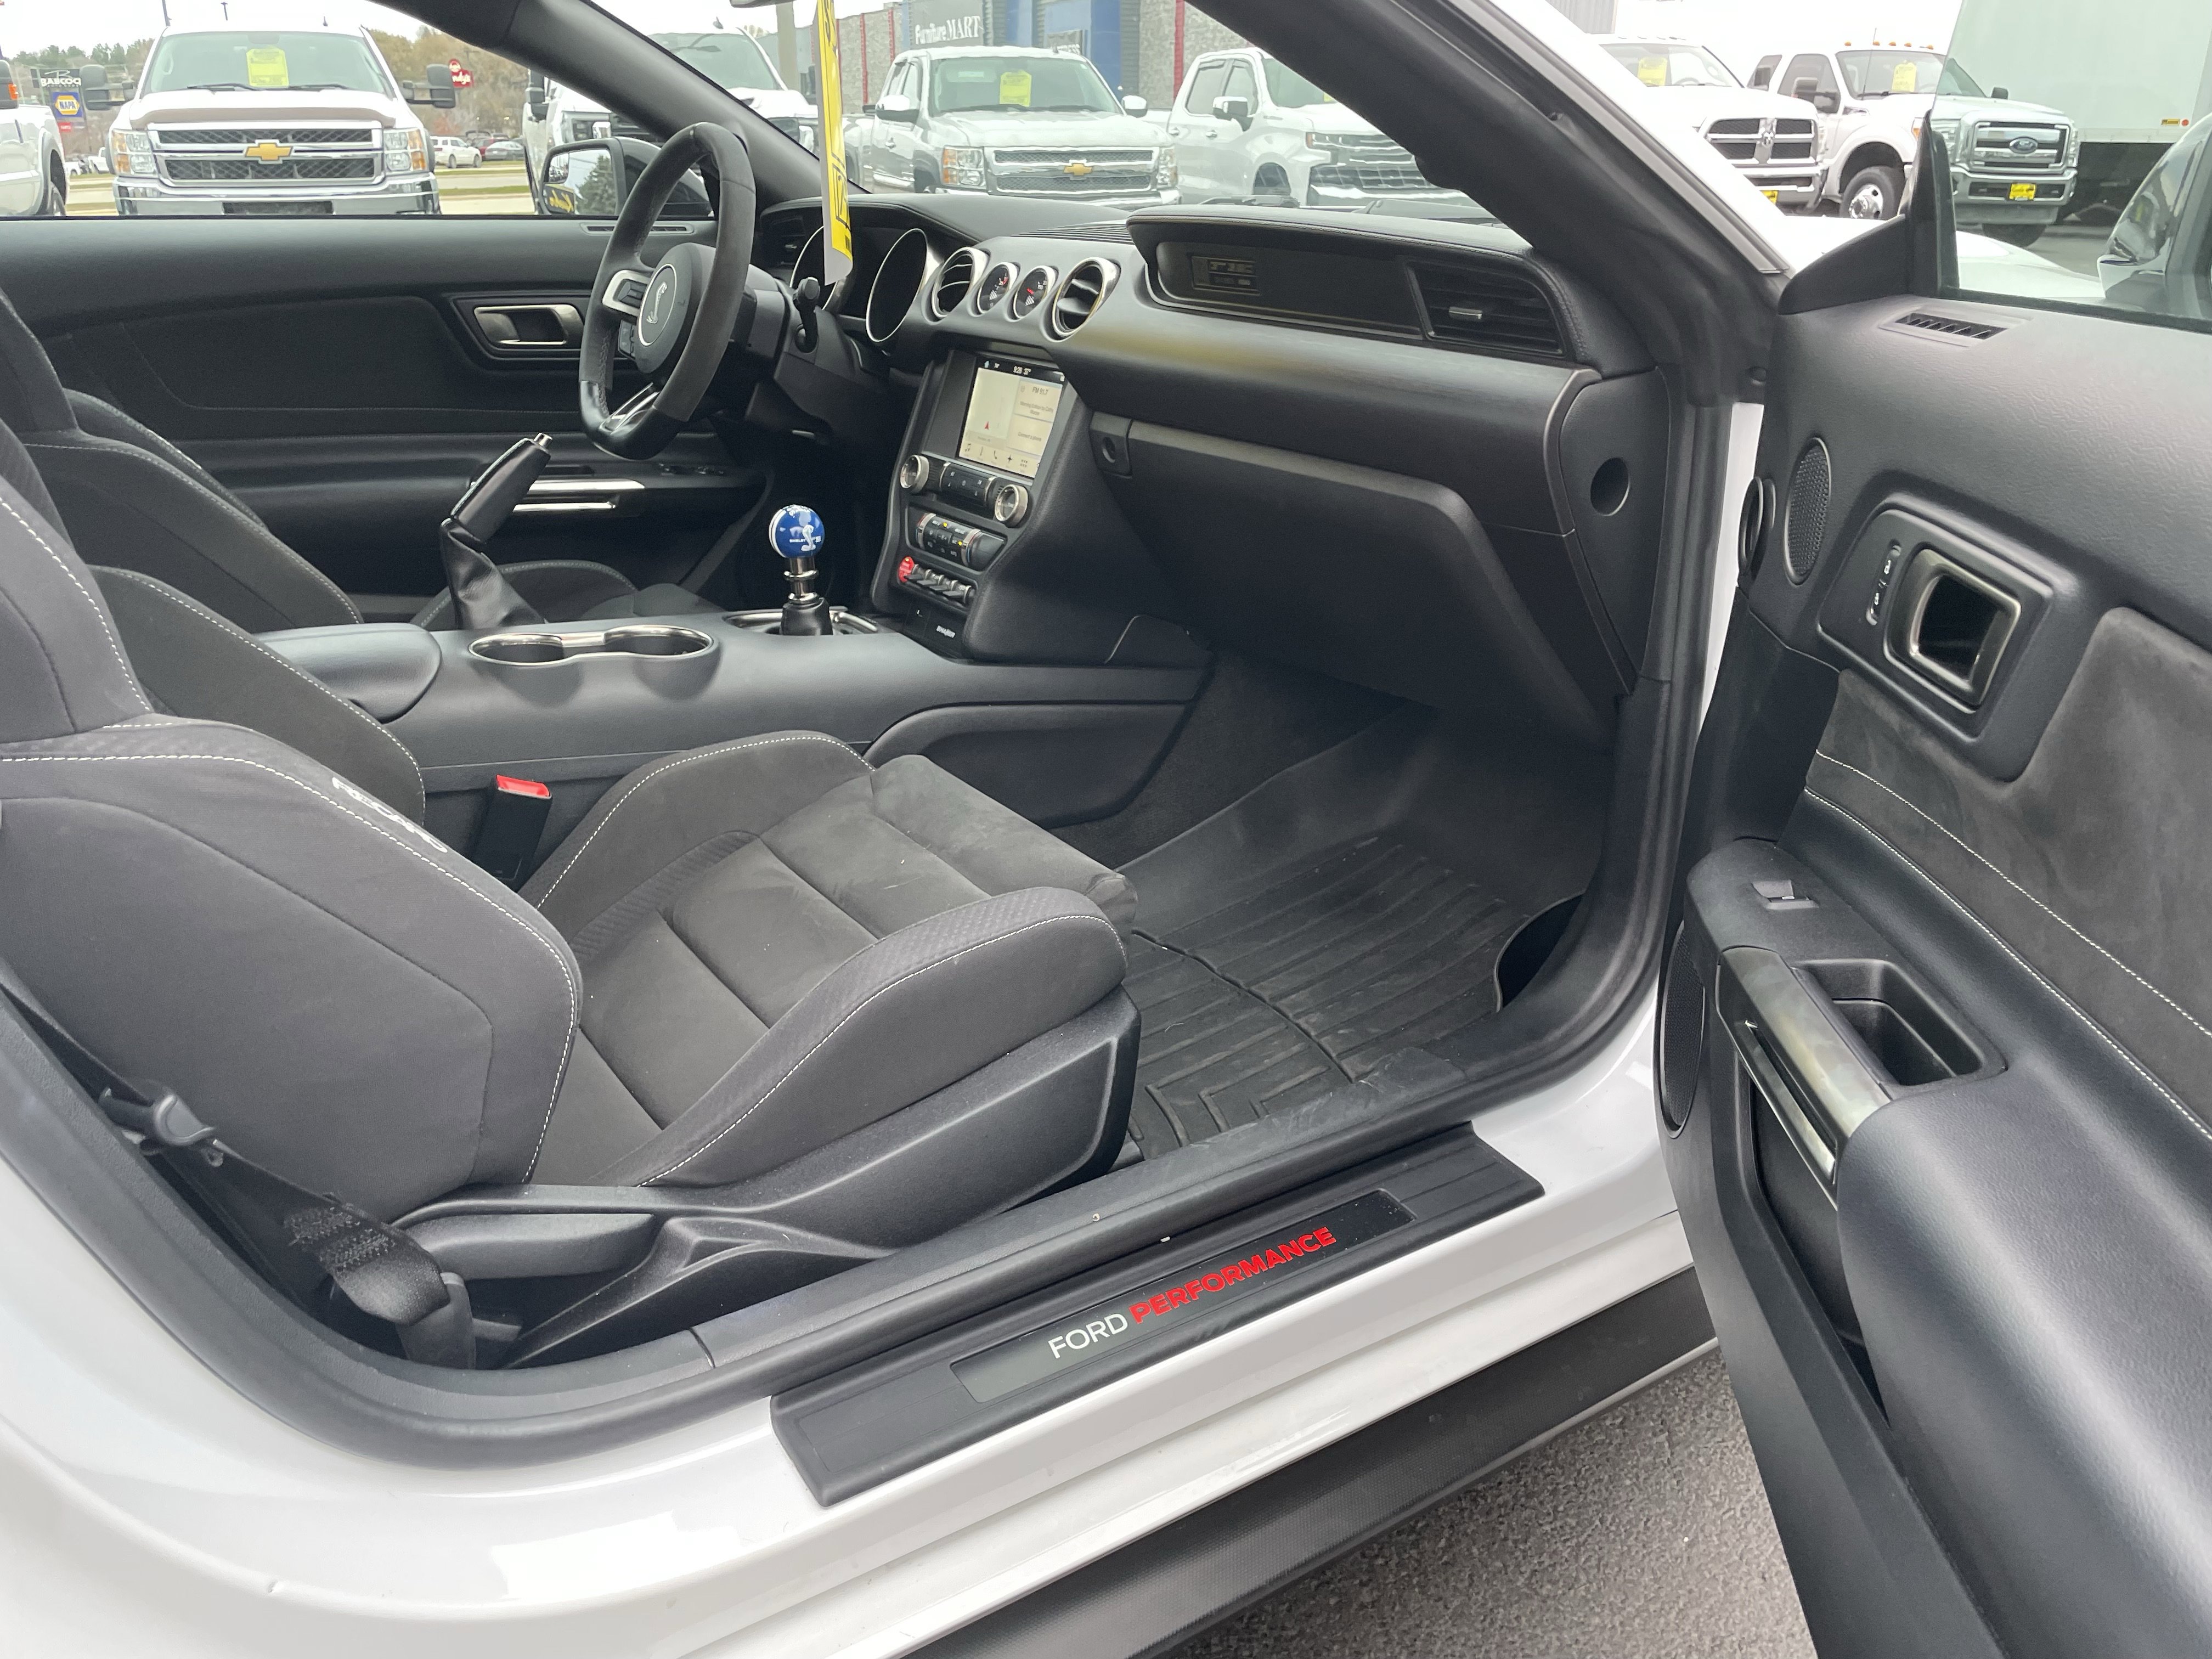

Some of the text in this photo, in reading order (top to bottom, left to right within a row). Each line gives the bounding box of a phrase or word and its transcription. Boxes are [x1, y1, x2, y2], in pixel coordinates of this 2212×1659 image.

[59, 101, 76, 110] NAPA
[1048, 1227, 1337, 1359] FORD PERFORMANCE
